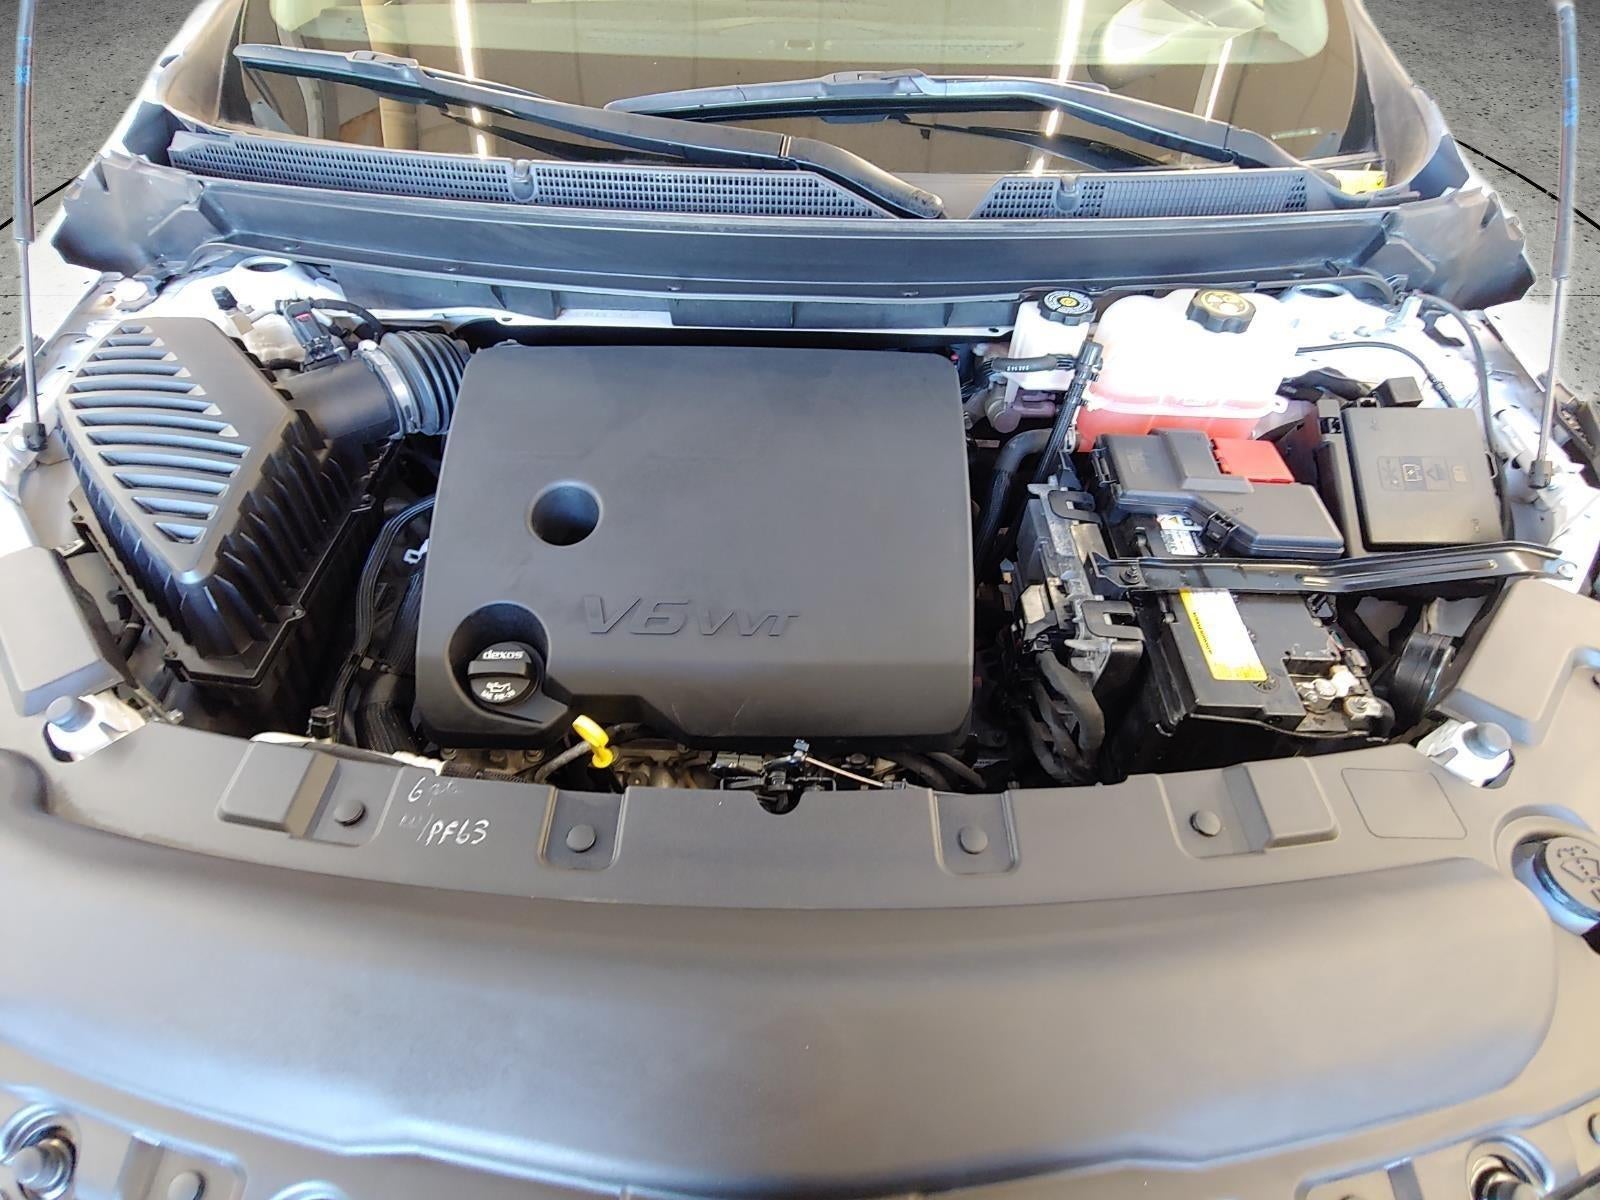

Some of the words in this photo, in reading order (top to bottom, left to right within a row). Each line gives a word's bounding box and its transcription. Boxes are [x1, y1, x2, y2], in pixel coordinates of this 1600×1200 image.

[584, 596, 689, 636] V6
[699, 608, 800, 638] VVT
[482, 649, 525, 660] dexos
[407, 776, 426, 802] 6
